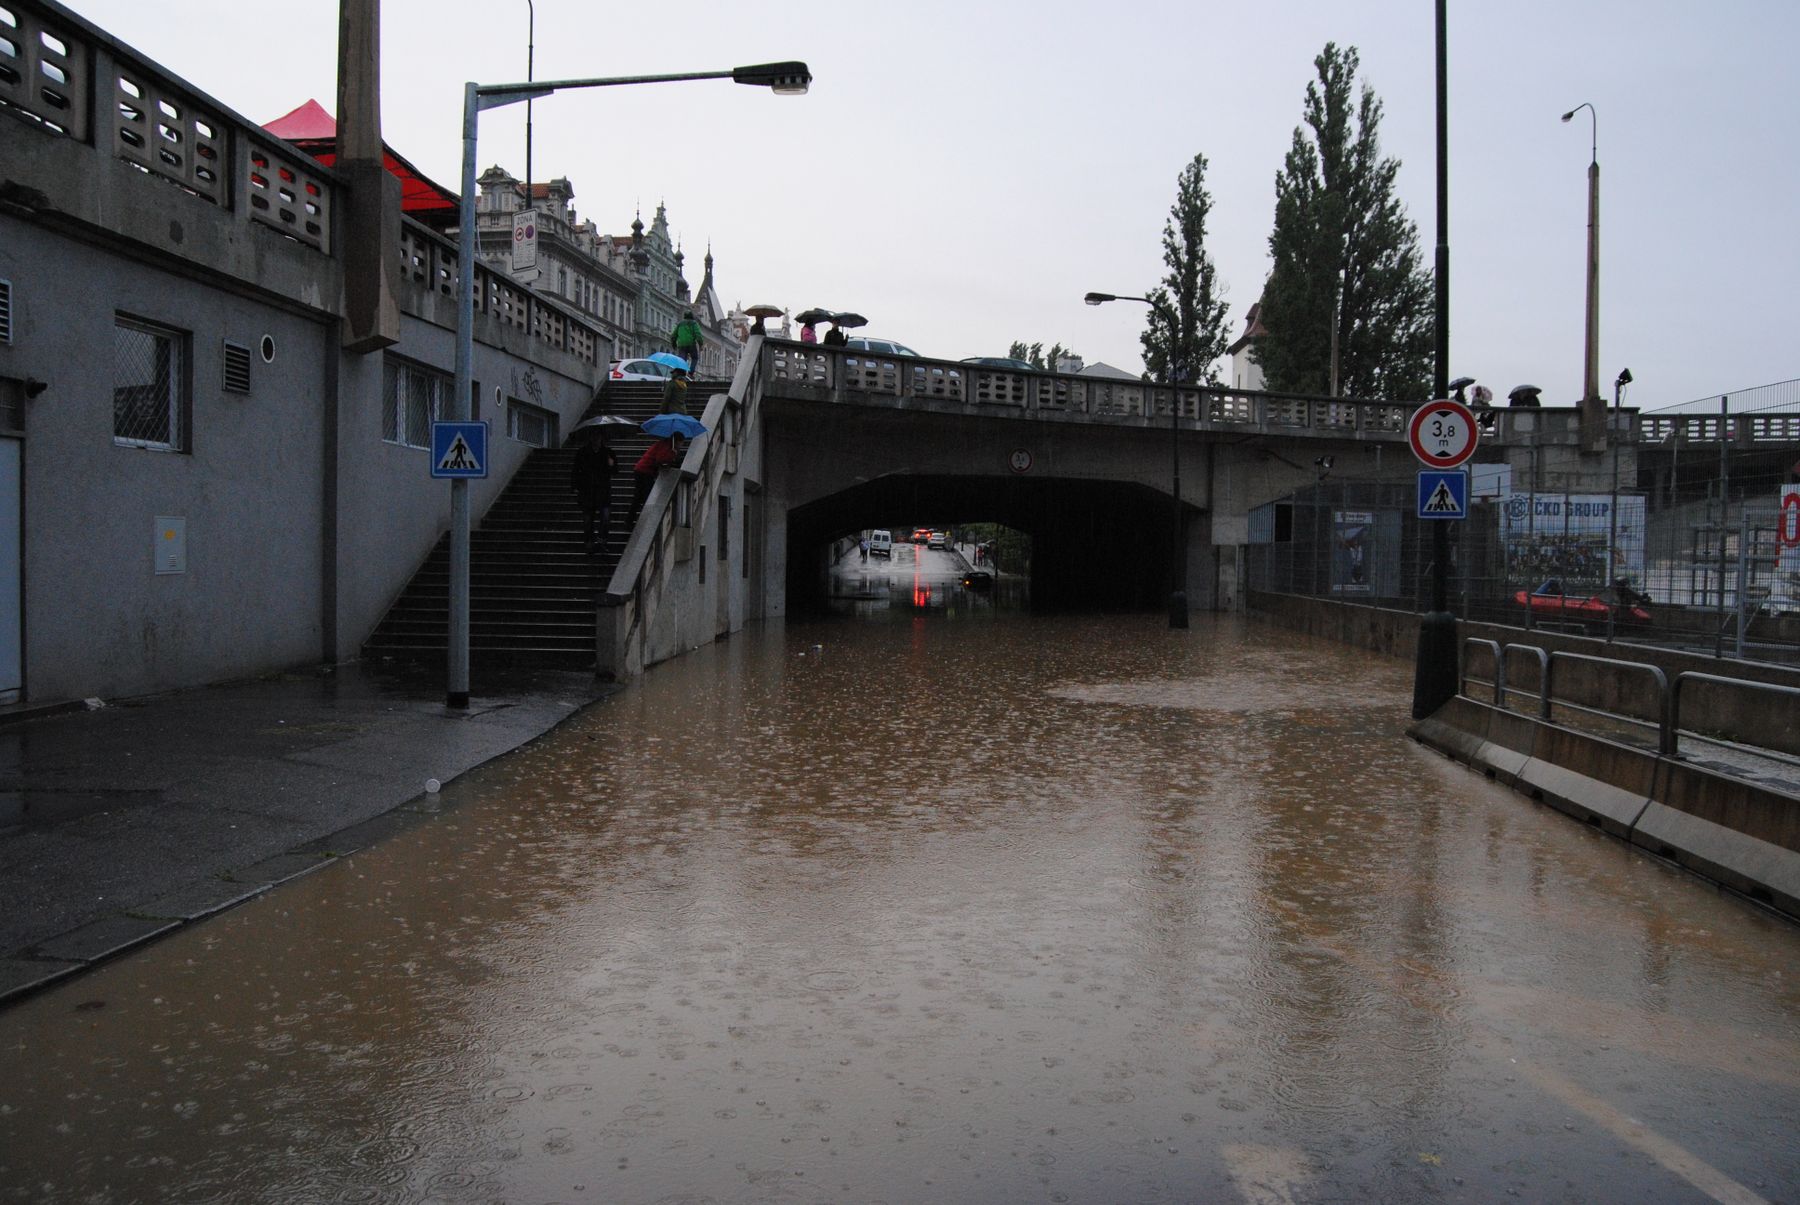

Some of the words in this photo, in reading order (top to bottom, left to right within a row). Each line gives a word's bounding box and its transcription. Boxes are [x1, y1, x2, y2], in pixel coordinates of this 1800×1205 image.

[517, 215, 533, 225] ZONA
[1432, 420, 1455, 438] 3,8
[1439, 439, 1449, 447] m
[1535, 496, 1560, 516] ČKD
[1567, 502, 1609, 517] GROUP
